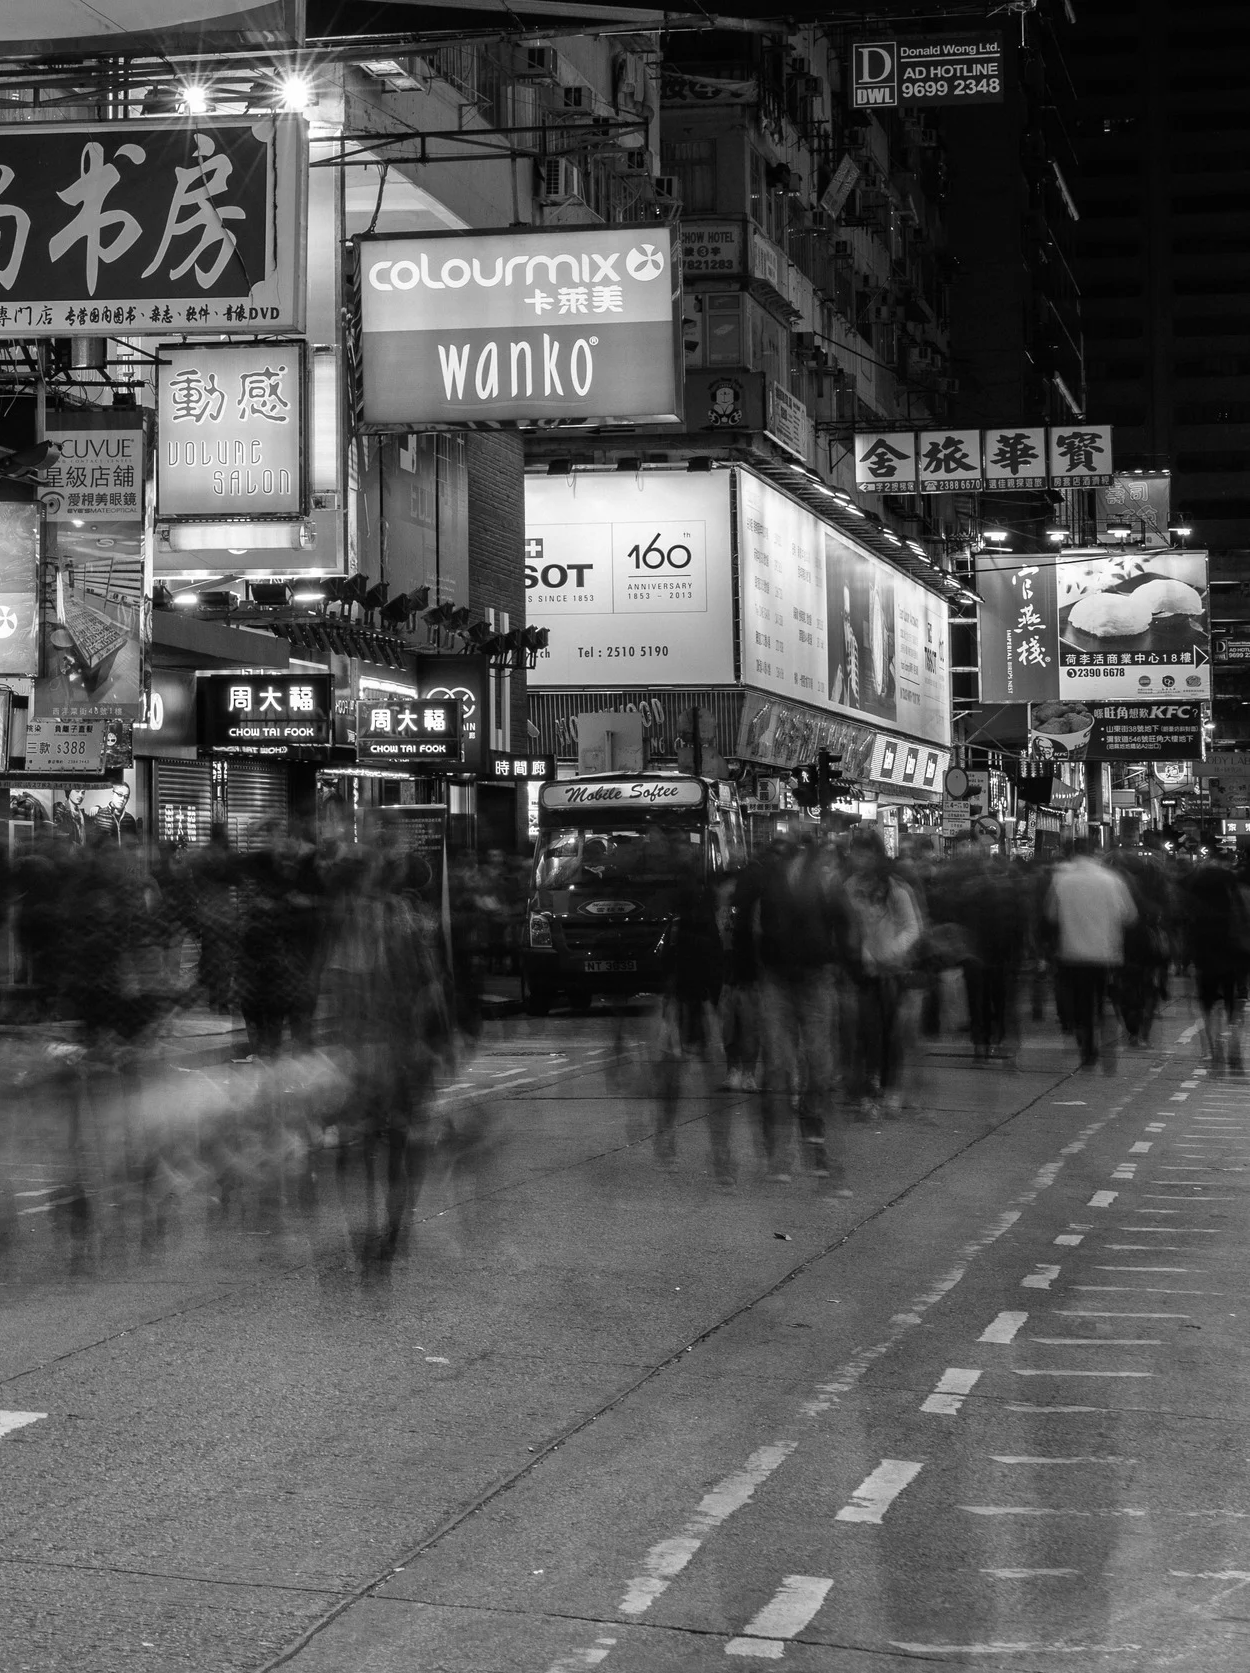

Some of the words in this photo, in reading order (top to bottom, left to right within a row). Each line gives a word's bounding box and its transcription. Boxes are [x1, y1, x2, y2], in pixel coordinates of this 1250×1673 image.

[901, 46, 940, 57] Donald
[943, 45, 976, 55] Wong
[979, 42, 1000, 52] Ltd.
[858, 48, 891, 82] D
[903, 67, 926, 79] AD
[931, 63, 999, 78] HOTLINE
[902, 81, 948, 97] 9699
[953, 78, 1000, 95] 2348
[857, 88, 893, 104] DWL
[708, 232, 735, 243] HOTEL
[524, 285, 623, 315] 卡萊美
[438, 333, 594, 400] wanko
[169, 365, 291, 425] 動感
[213, 469, 291, 496] SALON
[939, 480, 959, 490] 2388
[960, 479, 981, 489] 6670
[627, 533, 692, 569] 160
[607, 646, 635, 658] 2510
[640, 646, 669, 657] 5190
[1078, 668, 1101, 678] 2390
[1103, 668, 1125, 678] 6678
[229, 686, 314, 712] 周大福
[370, 708, 446, 732] 周大福
[229, 727, 260, 738] CHOW
[262, 727, 280, 738] TAI
[284, 727, 314, 738] FOOK
[57, 741, 86, 755] $388
[370, 744, 398, 754] CHOW
[400, 744, 416, 754] TAI
[419, 744, 446, 754] FOOK
[495, 760, 545, 777] 時間廊
[565, 786, 622, 803] Mobile
[629, 784, 679, 802] Softee
[588, 962, 602, 970] NT
